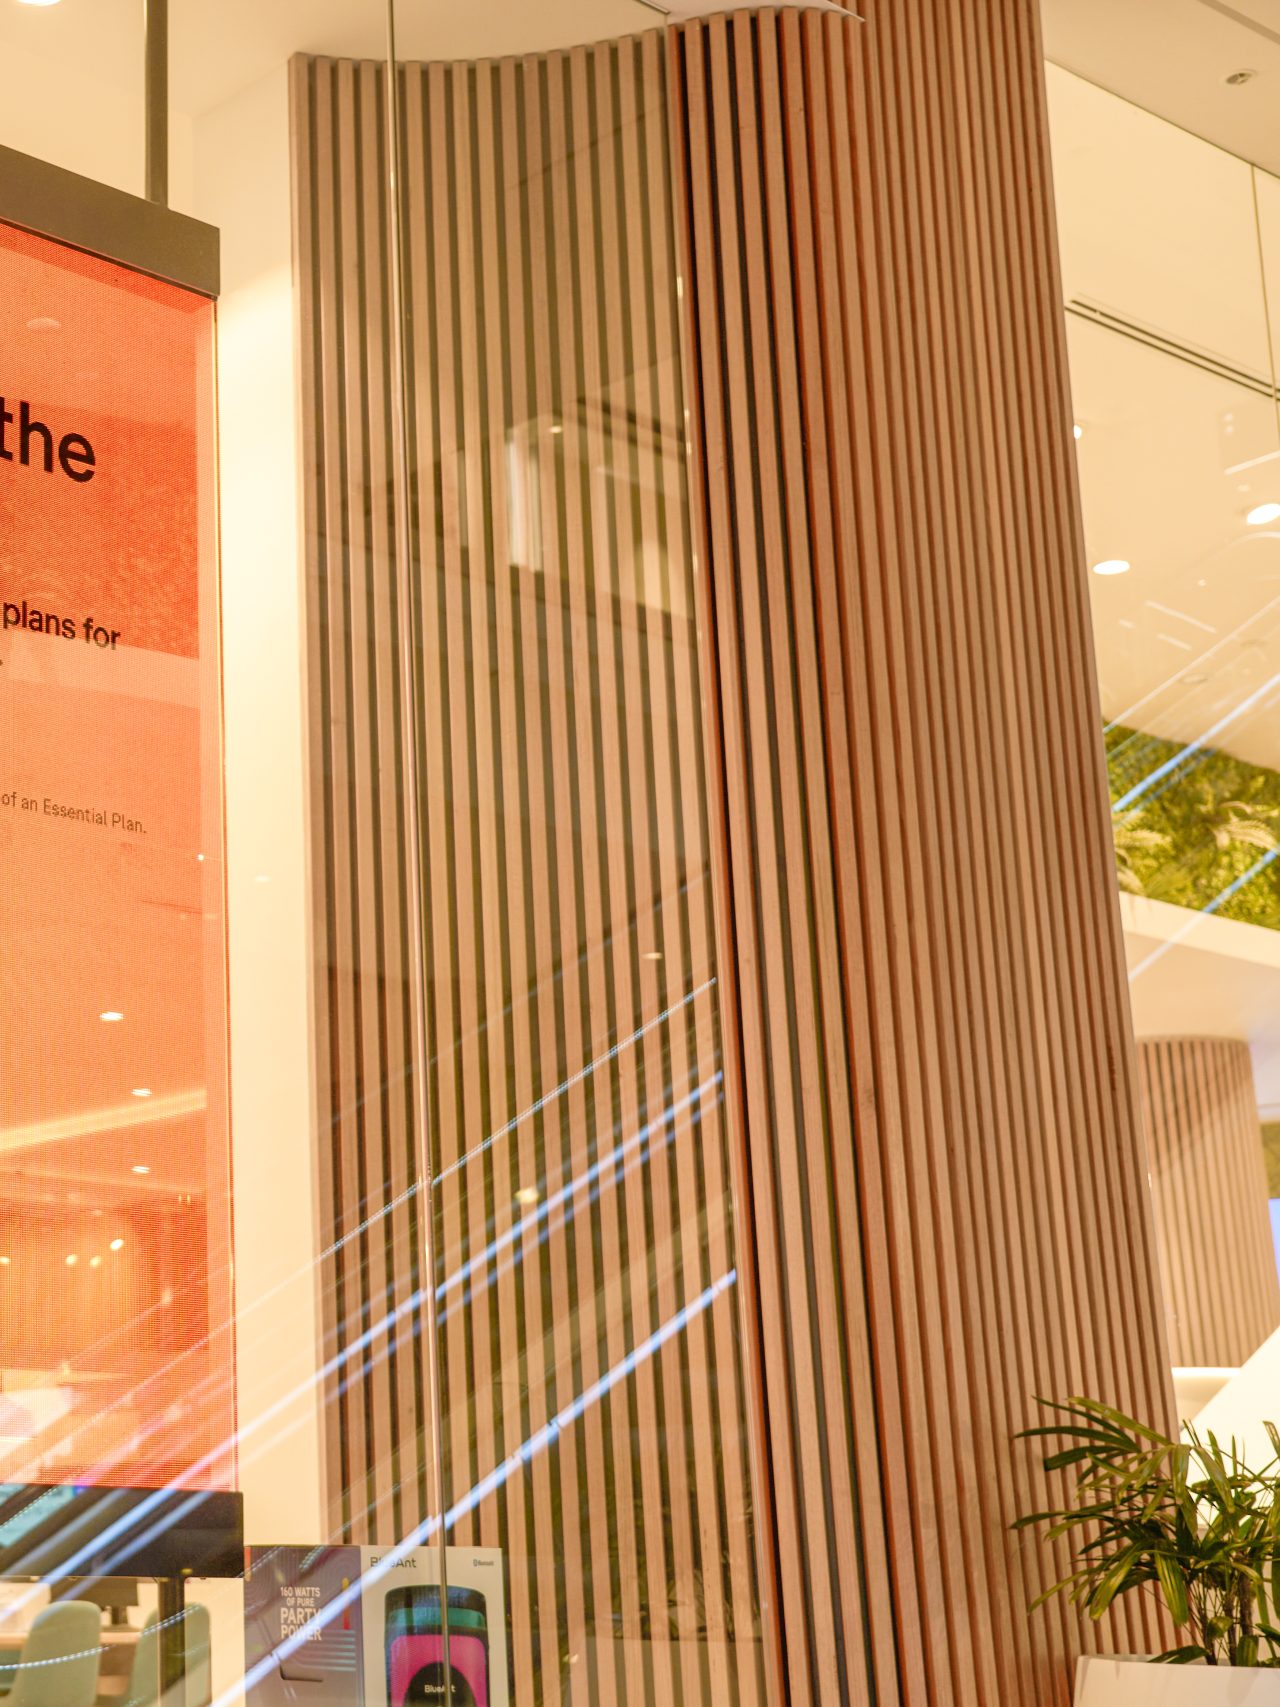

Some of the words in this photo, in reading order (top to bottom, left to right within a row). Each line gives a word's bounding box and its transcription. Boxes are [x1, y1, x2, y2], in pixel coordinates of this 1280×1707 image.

[3, 601, 76, 639] plans
[83, 616, 121, 650] for
[1, 789, 19, 807] of
[21, 795, 39, 812] an
[43, 798, 108, 827] Essential
[111, 812, 148, 835] Plan.
[280, 1586, 293, 1597] 160
[294, 1586, 321, 1597] WATTS
[286, 1597, 295, 1607] OF
[297, 1597, 315, 1607] PURE
